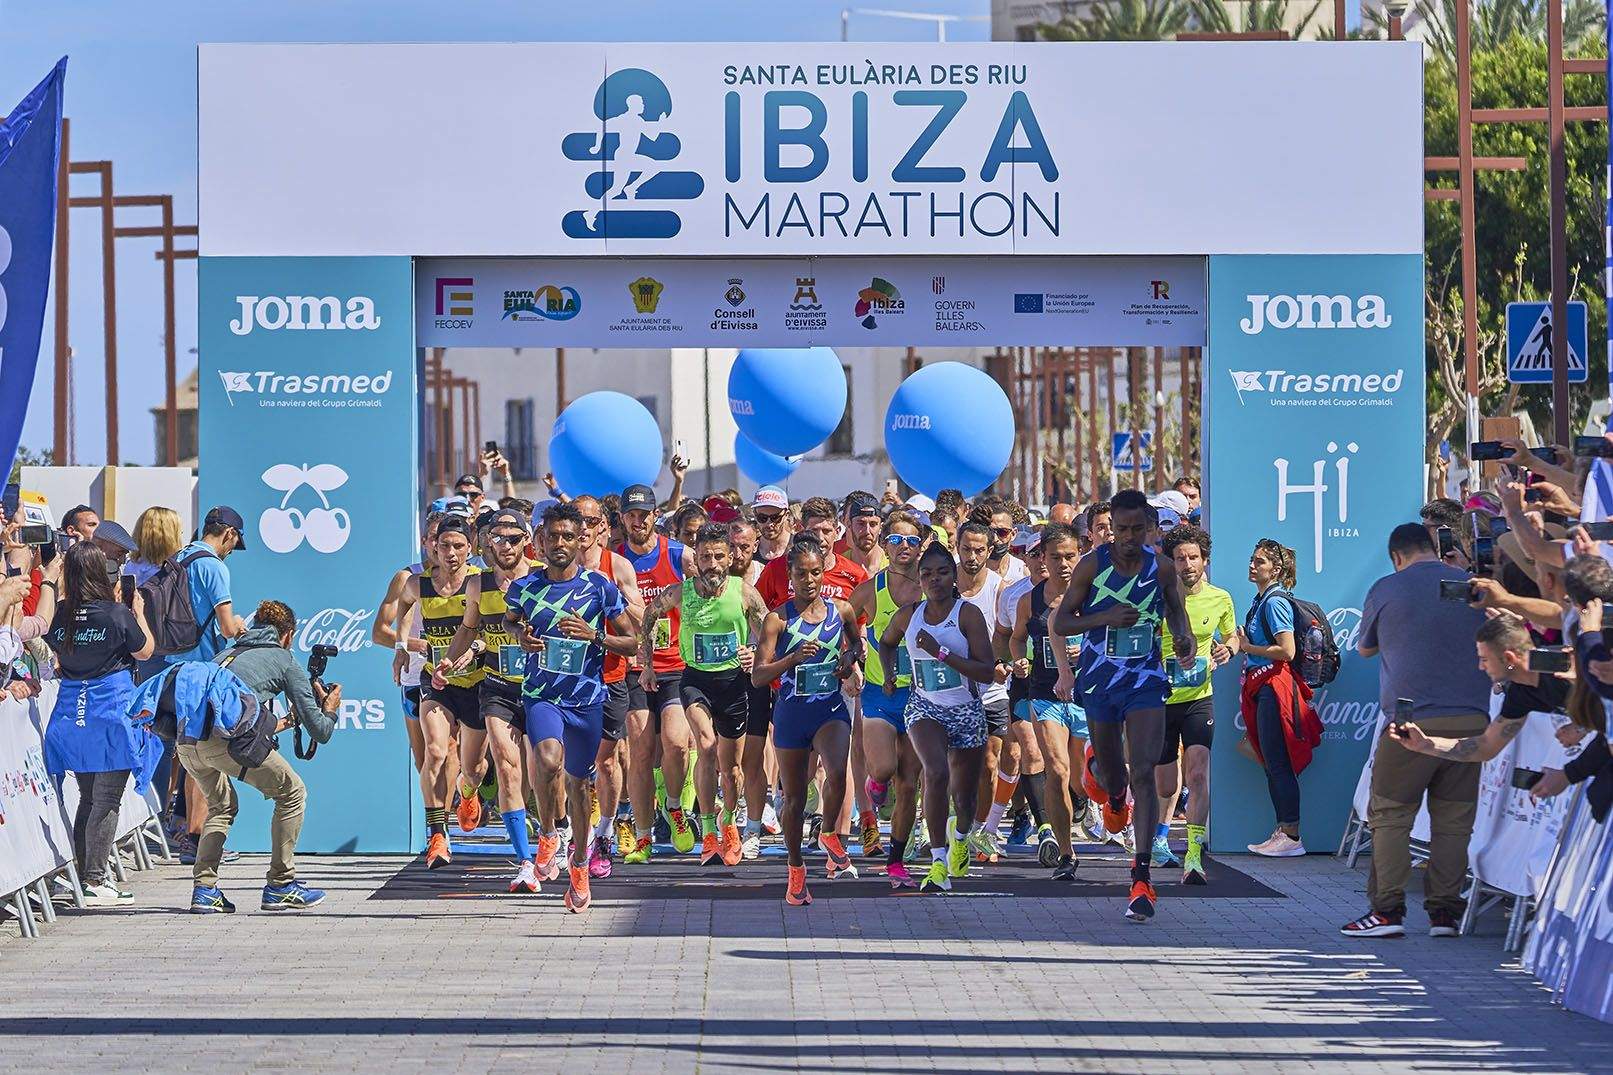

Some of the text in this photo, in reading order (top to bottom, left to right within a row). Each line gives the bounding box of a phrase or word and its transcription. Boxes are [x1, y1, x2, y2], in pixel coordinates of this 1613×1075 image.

[723, 59, 1028, 85] SANTA EULÀRIA DES RIU
[725, 90, 1059, 183] IBIZA
[725, 192, 1060, 237] MARATHON
[504, 291, 535, 299] SANTA
[935, 300, 976, 310] GOVERN
[714, 308, 755, 319] Consell
[936, 311, 965, 320] ILLES
[435, 320, 473, 329] FECOEV
[710, 319, 758, 331] d'Eivissa
[254, 370, 393, 394] Trasmed
[1264, 369, 1404, 393] Trasmed
[259, 399, 382, 409] Una naviera del Grupo Grimaldi
[729, 399, 754, 415] oma
[1270, 398, 1393, 408] Una naviera del Grupo Grimaldi
[1328, 528, 1360, 537] IBIZA
[1132, 638, 1138, 651] 1
[713, 646, 729, 657] 12
[561, 653, 571, 667] 2
[820, 676, 828, 687] 4
[937, 671, 946, 684] 3
